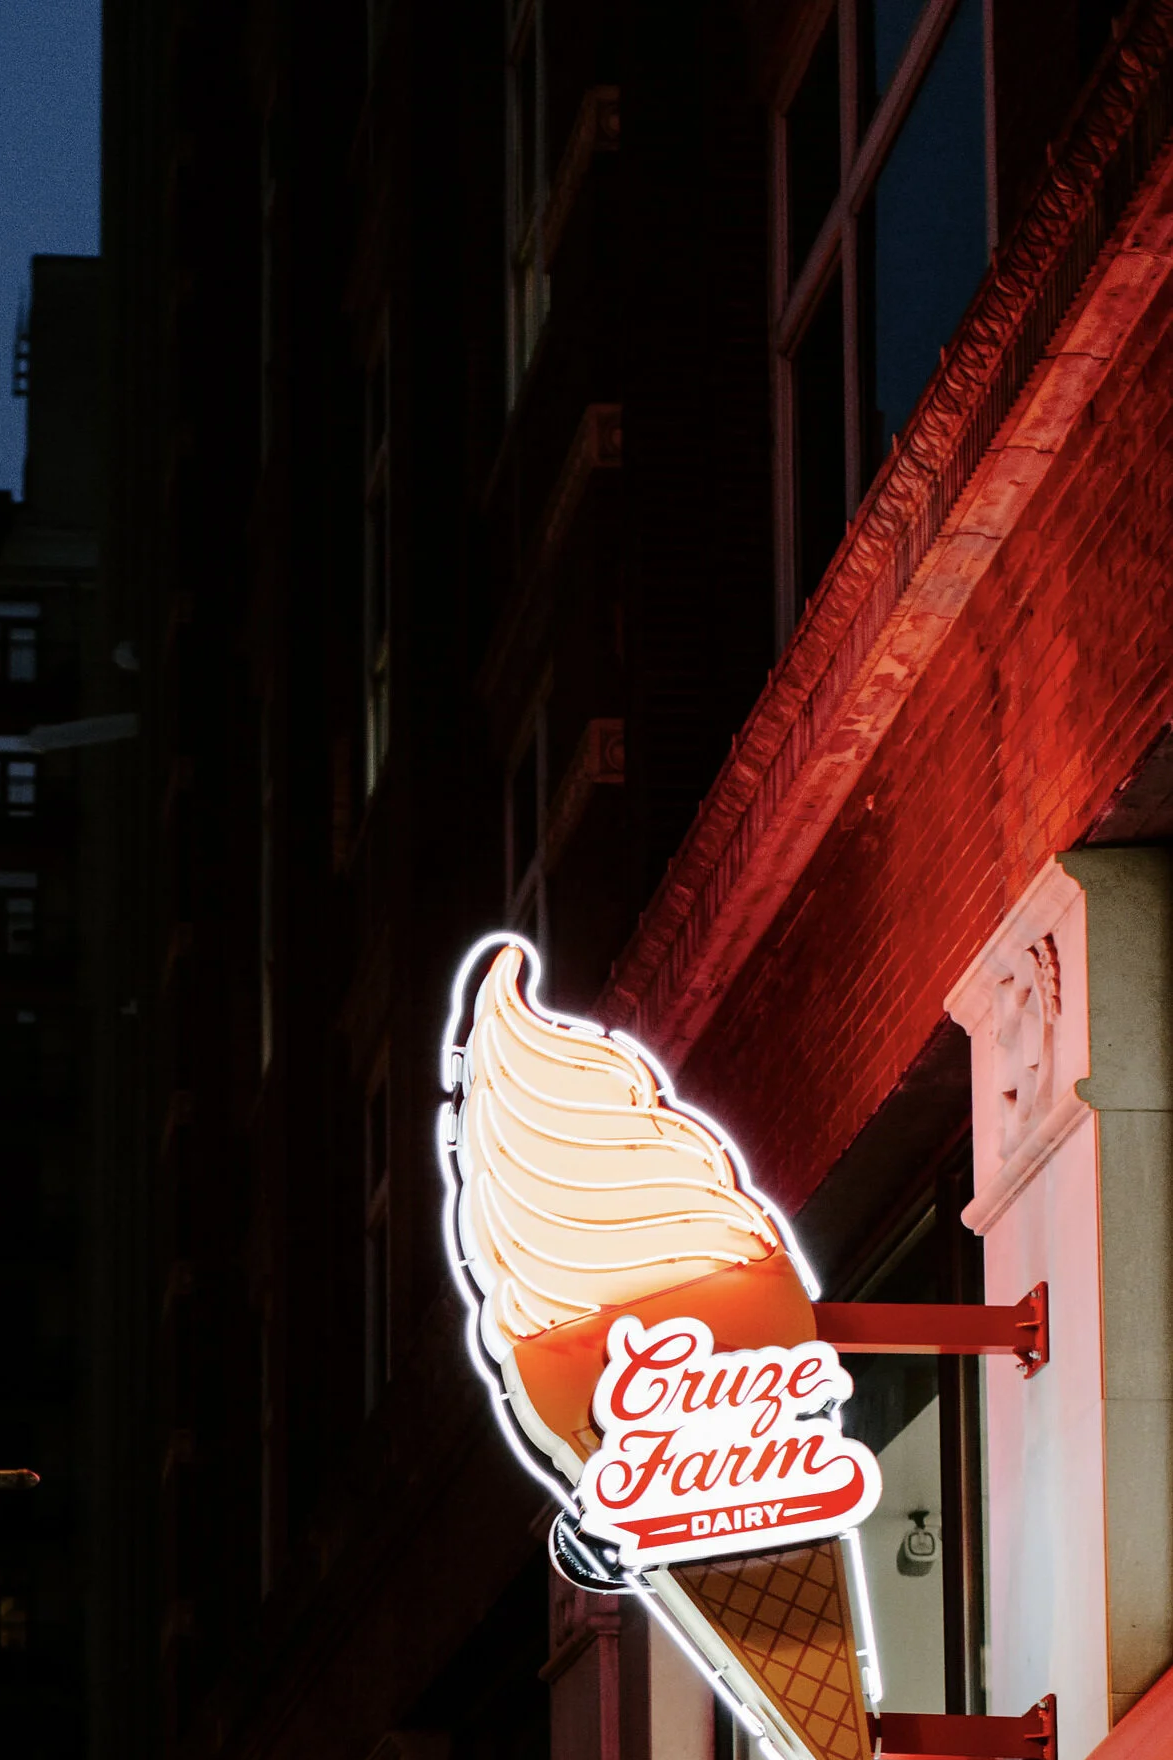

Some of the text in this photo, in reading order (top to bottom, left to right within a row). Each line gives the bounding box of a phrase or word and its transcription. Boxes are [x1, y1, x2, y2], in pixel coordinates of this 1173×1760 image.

[610, 1333, 833, 1438] Cruze
[596, 1425, 845, 1509] Farm
[691, 1503, 784, 1537] DAIRY
